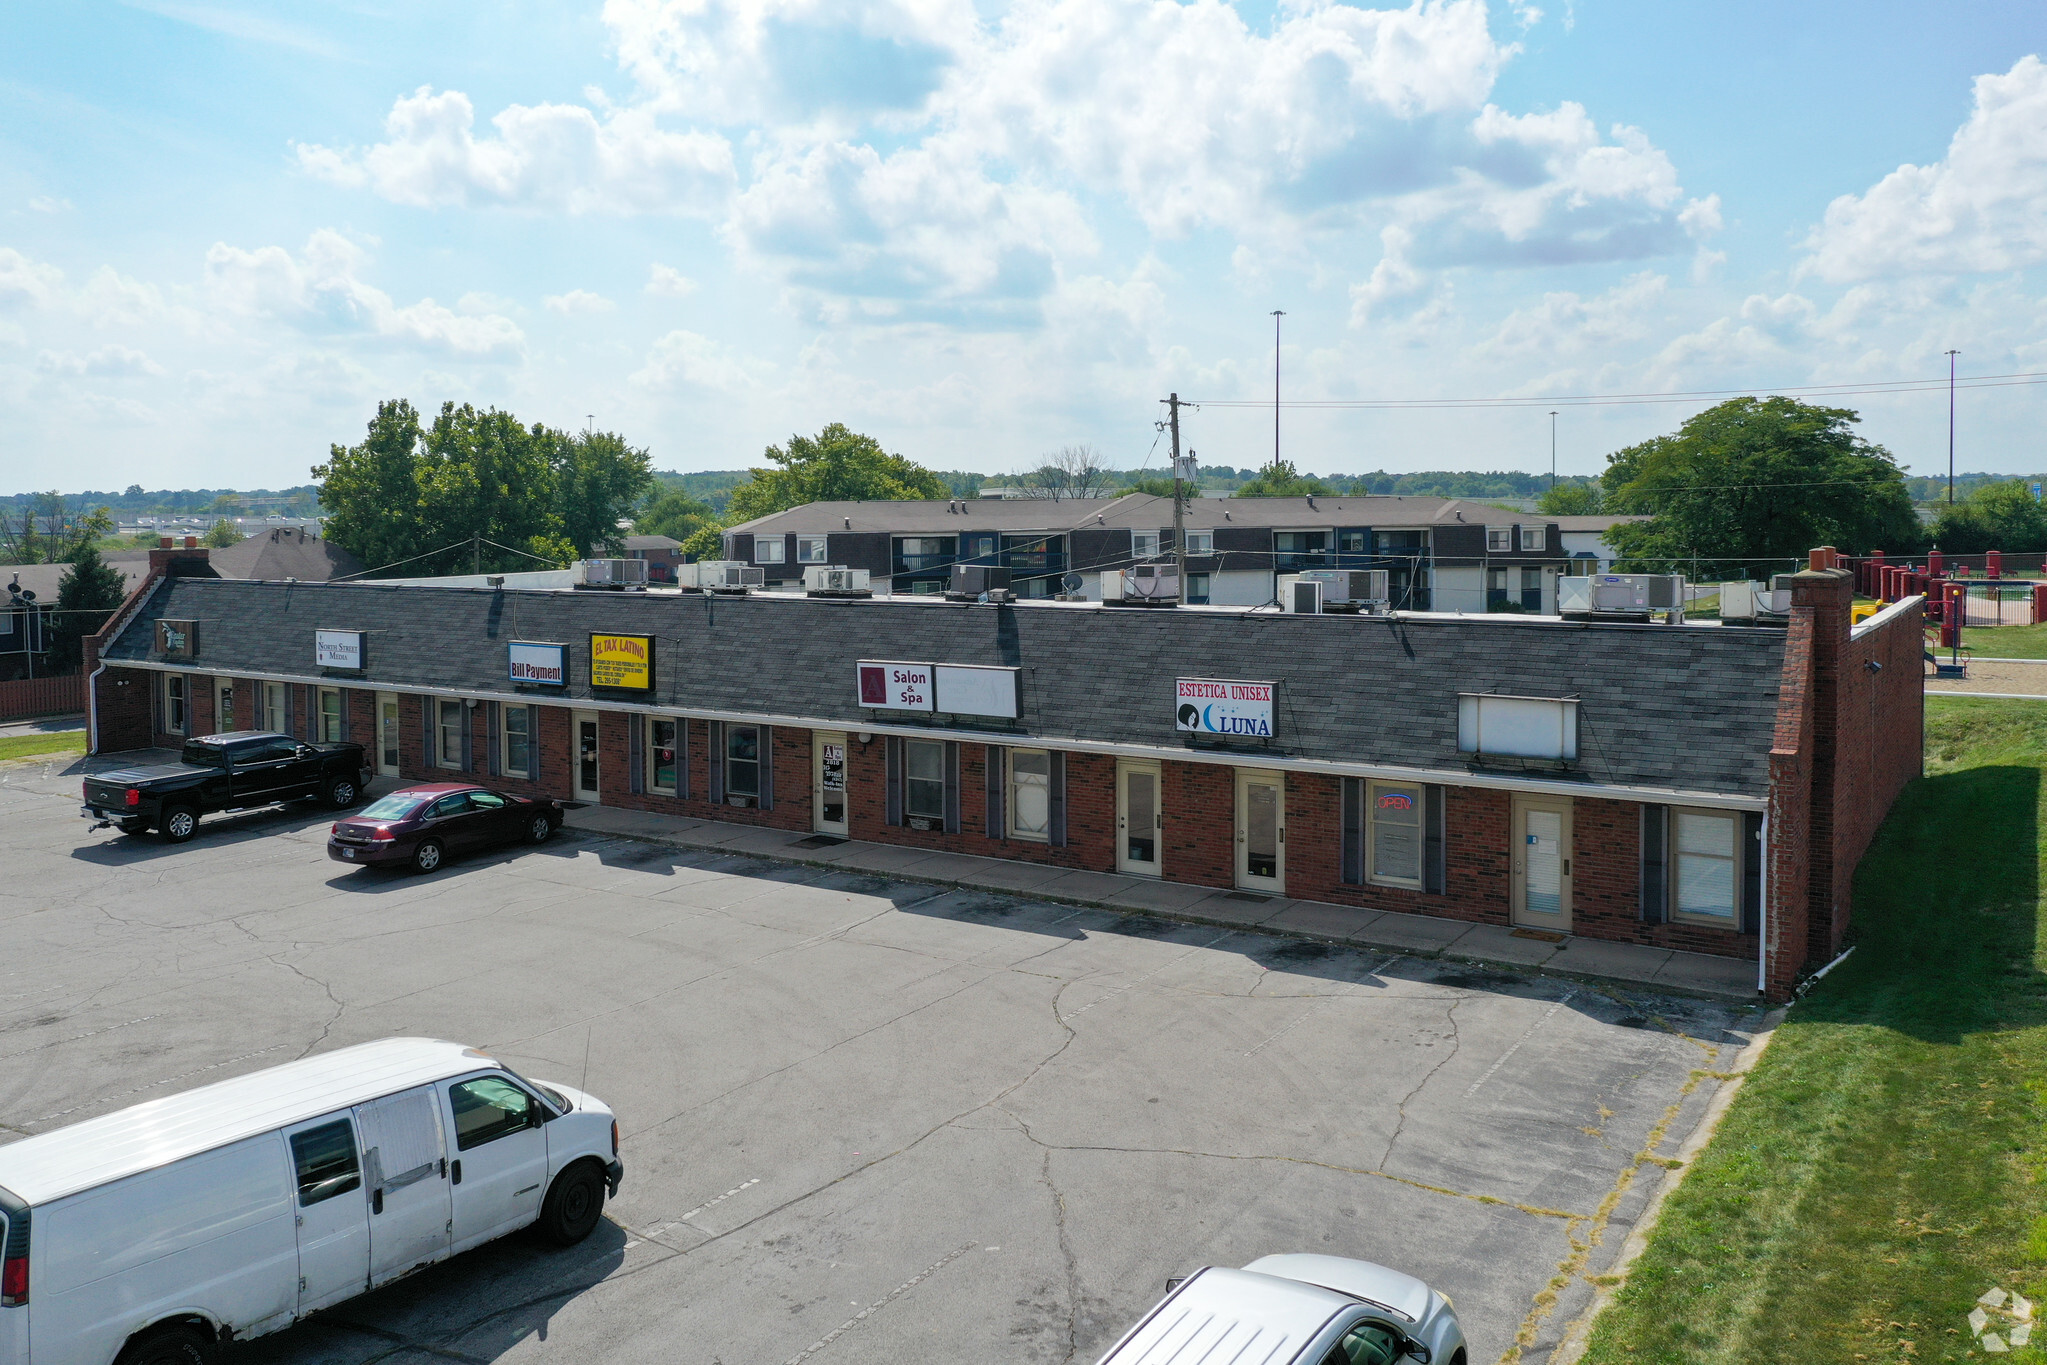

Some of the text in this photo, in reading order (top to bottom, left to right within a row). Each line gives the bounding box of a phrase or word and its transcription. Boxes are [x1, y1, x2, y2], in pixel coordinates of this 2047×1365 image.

[318, 642, 358, 651] NORTH STREET
[596, 638, 644, 660] EL TAX LATINO
[330, 651, 348, 660] MEDIA
[511, 662, 561, 680] Bill Payment
[893, 670, 926, 684] Salon
[1178, 682, 1271, 701] ESTETICA UNISEX
[900, 692, 923, 706] Spa
[1220, 716, 1270, 736] LUNA
[1378, 796, 1411, 810] OPEN
